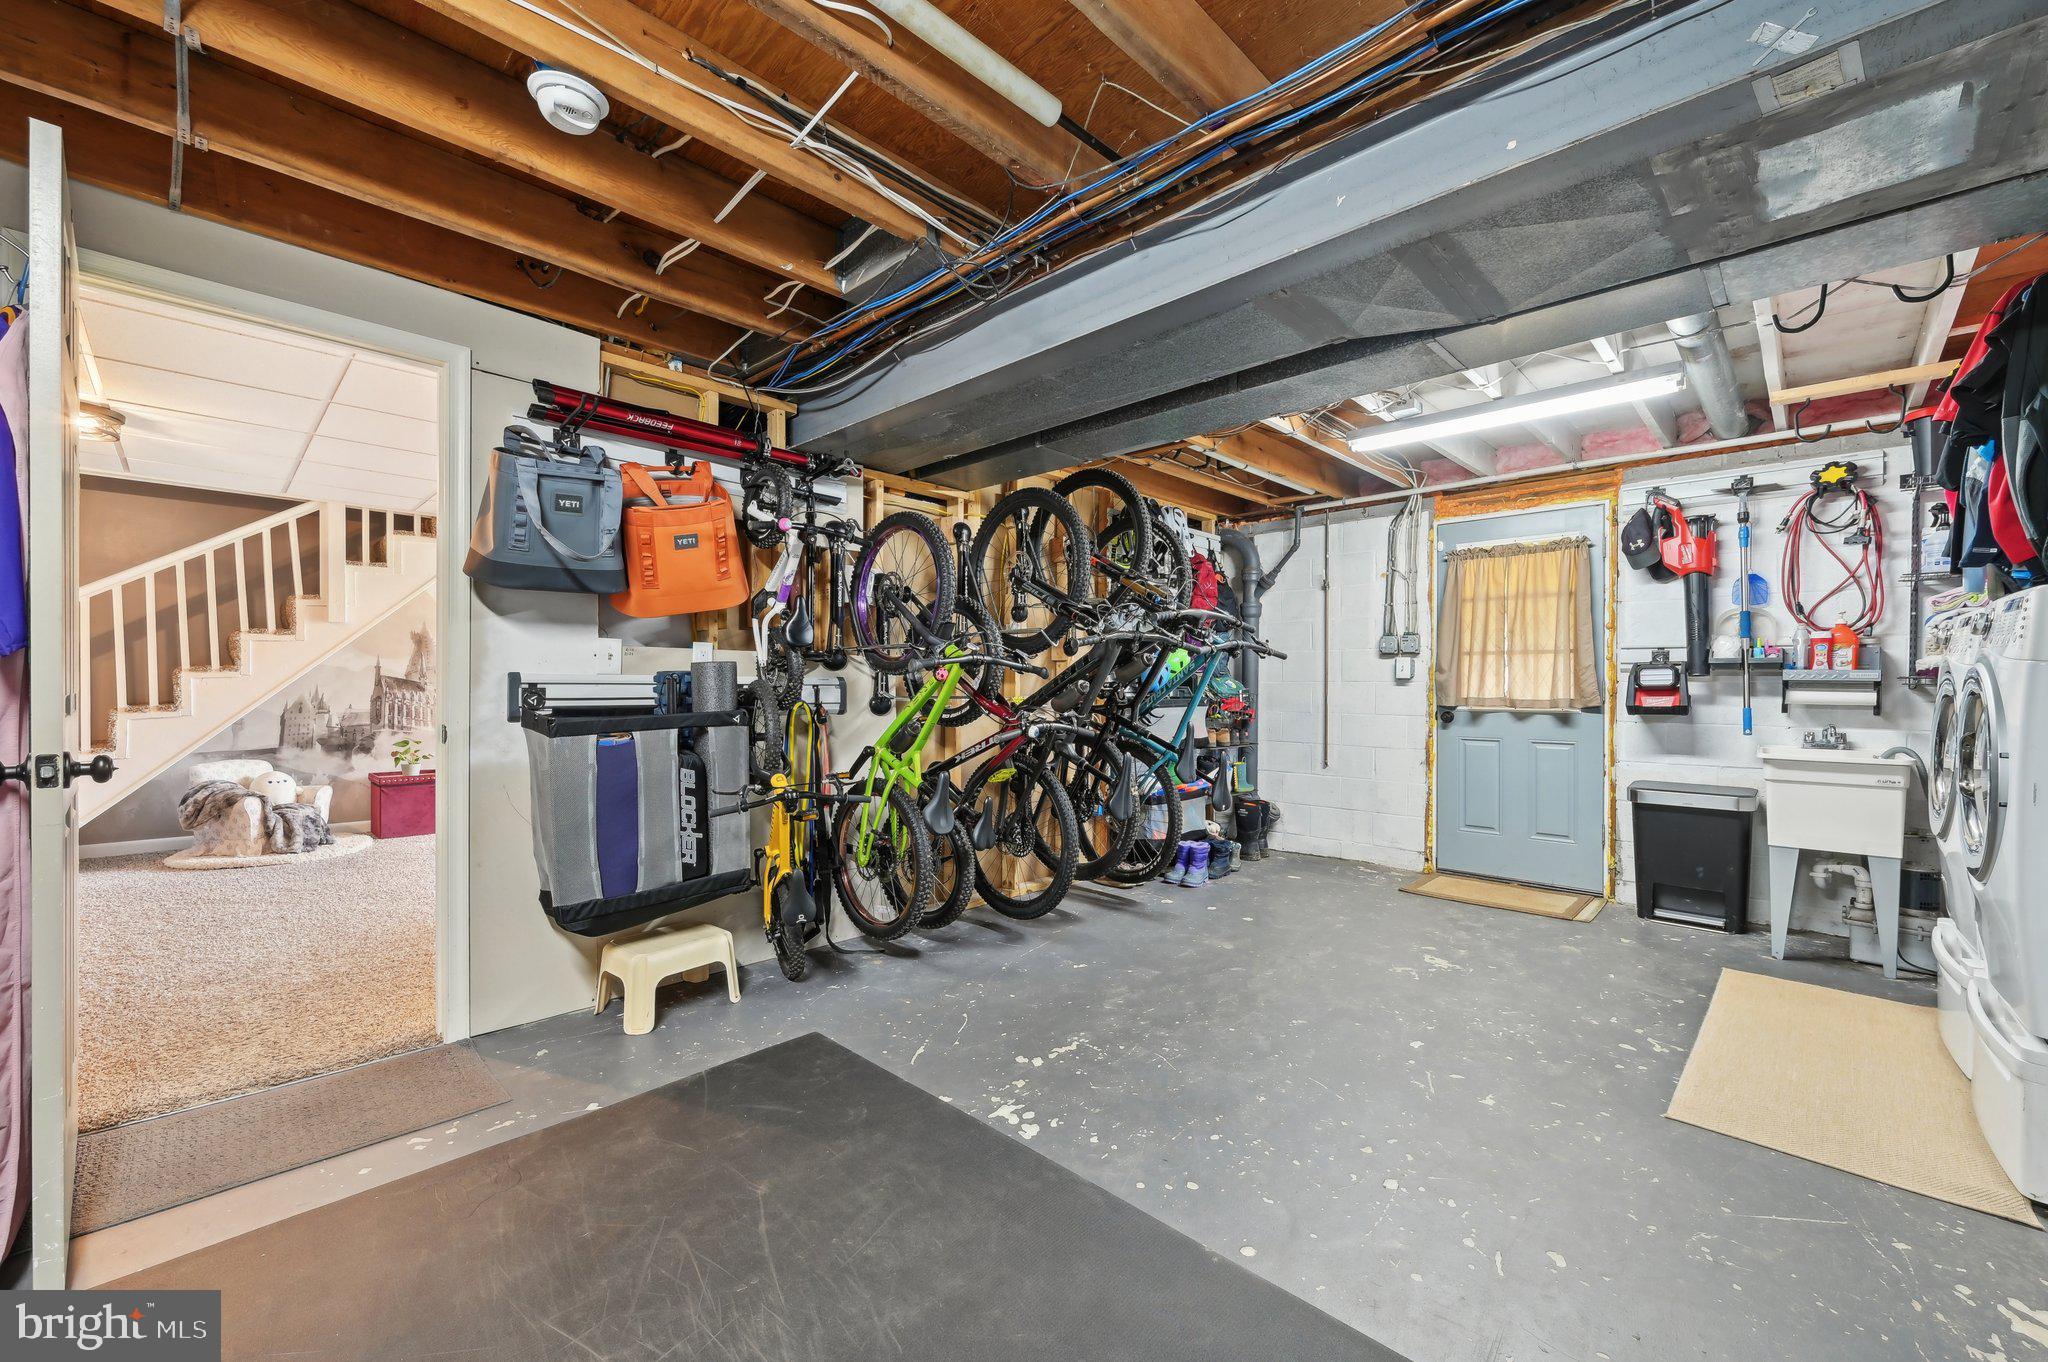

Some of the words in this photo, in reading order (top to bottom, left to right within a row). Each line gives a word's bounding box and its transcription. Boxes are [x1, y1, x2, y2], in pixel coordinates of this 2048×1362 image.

[626, 413, 675, 431] FEEDBACK
[558, 499, 580, 508] YETI
[677, 538, 696, 546] YETI
[954, 737, 997, 763] TREK
[680, 767, 703, 867] BLOCKER
